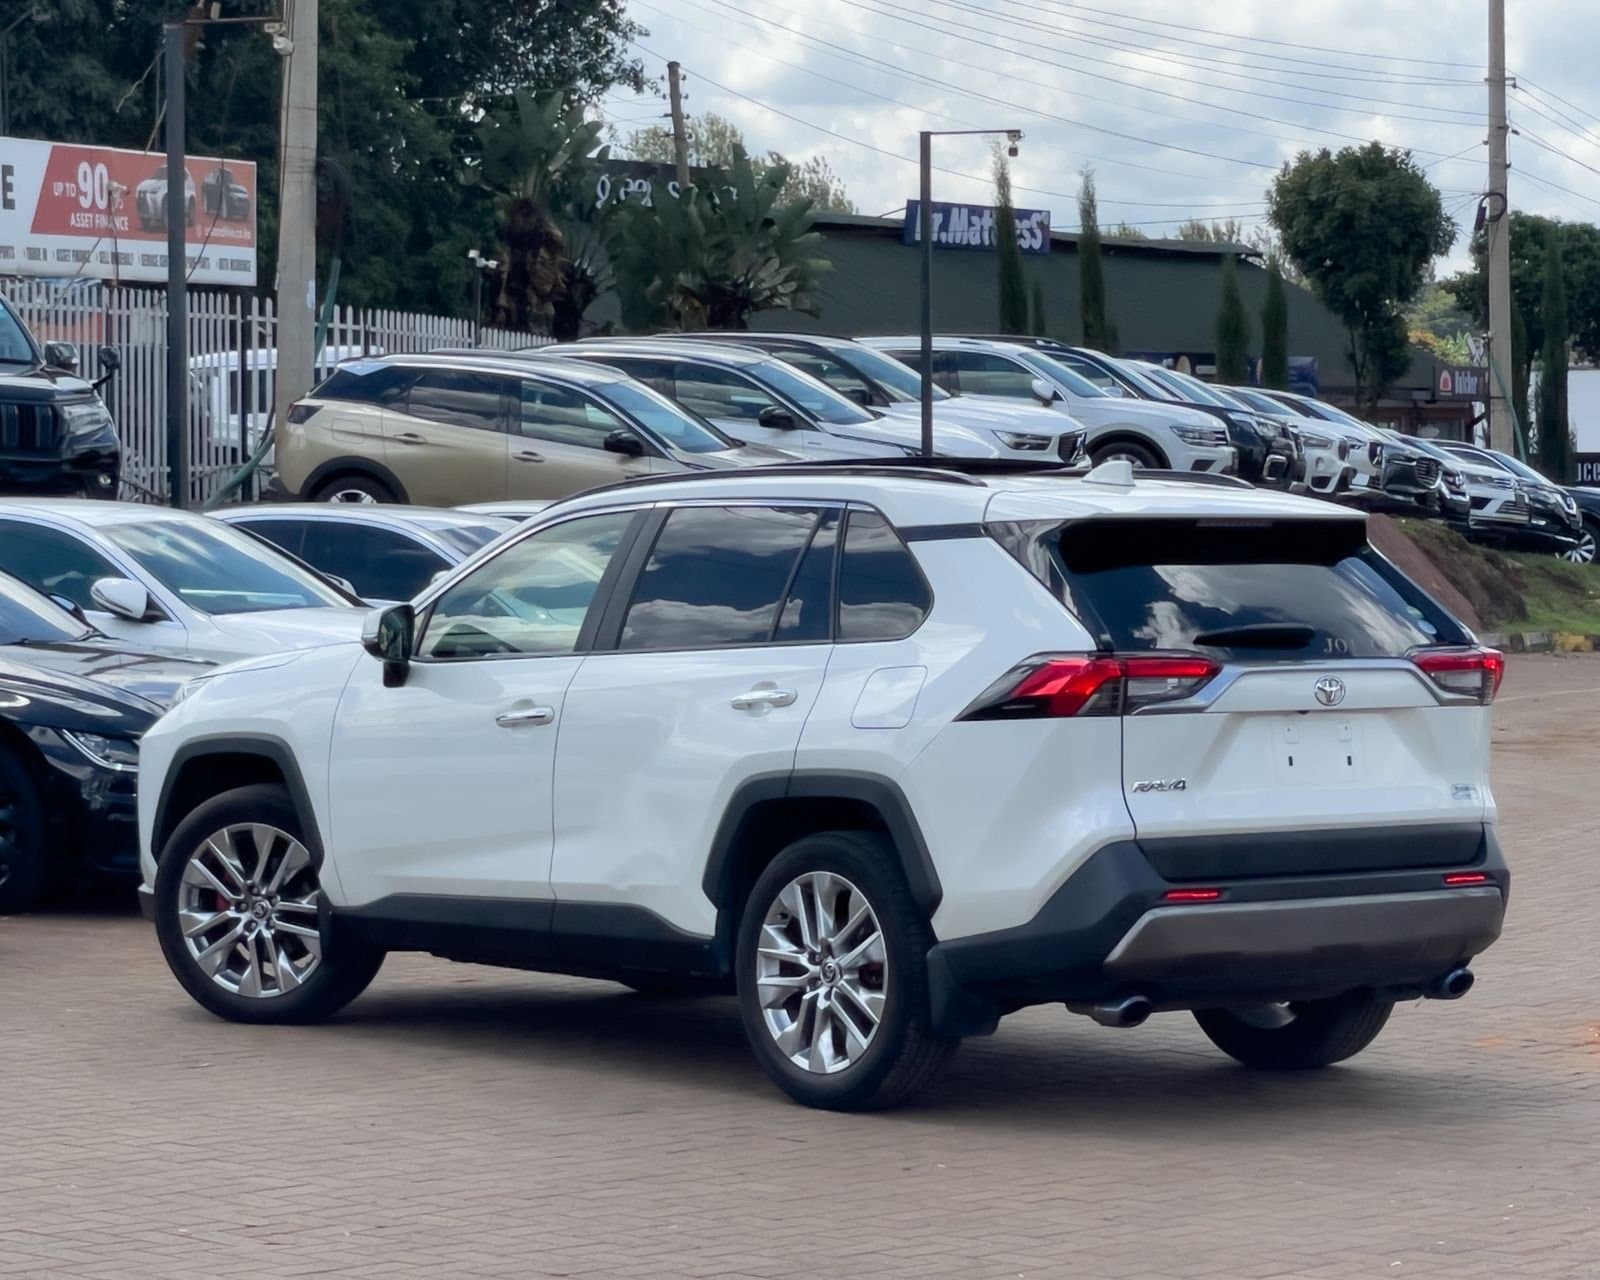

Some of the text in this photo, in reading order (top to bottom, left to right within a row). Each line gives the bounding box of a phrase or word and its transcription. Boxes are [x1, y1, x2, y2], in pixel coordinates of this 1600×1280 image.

[53, 181, 64, 197] UP
[65, 182, 77, 198] TO
[70, 211, 94, 228] ASSET
[1132, 778, 1187, 793] RAV4
